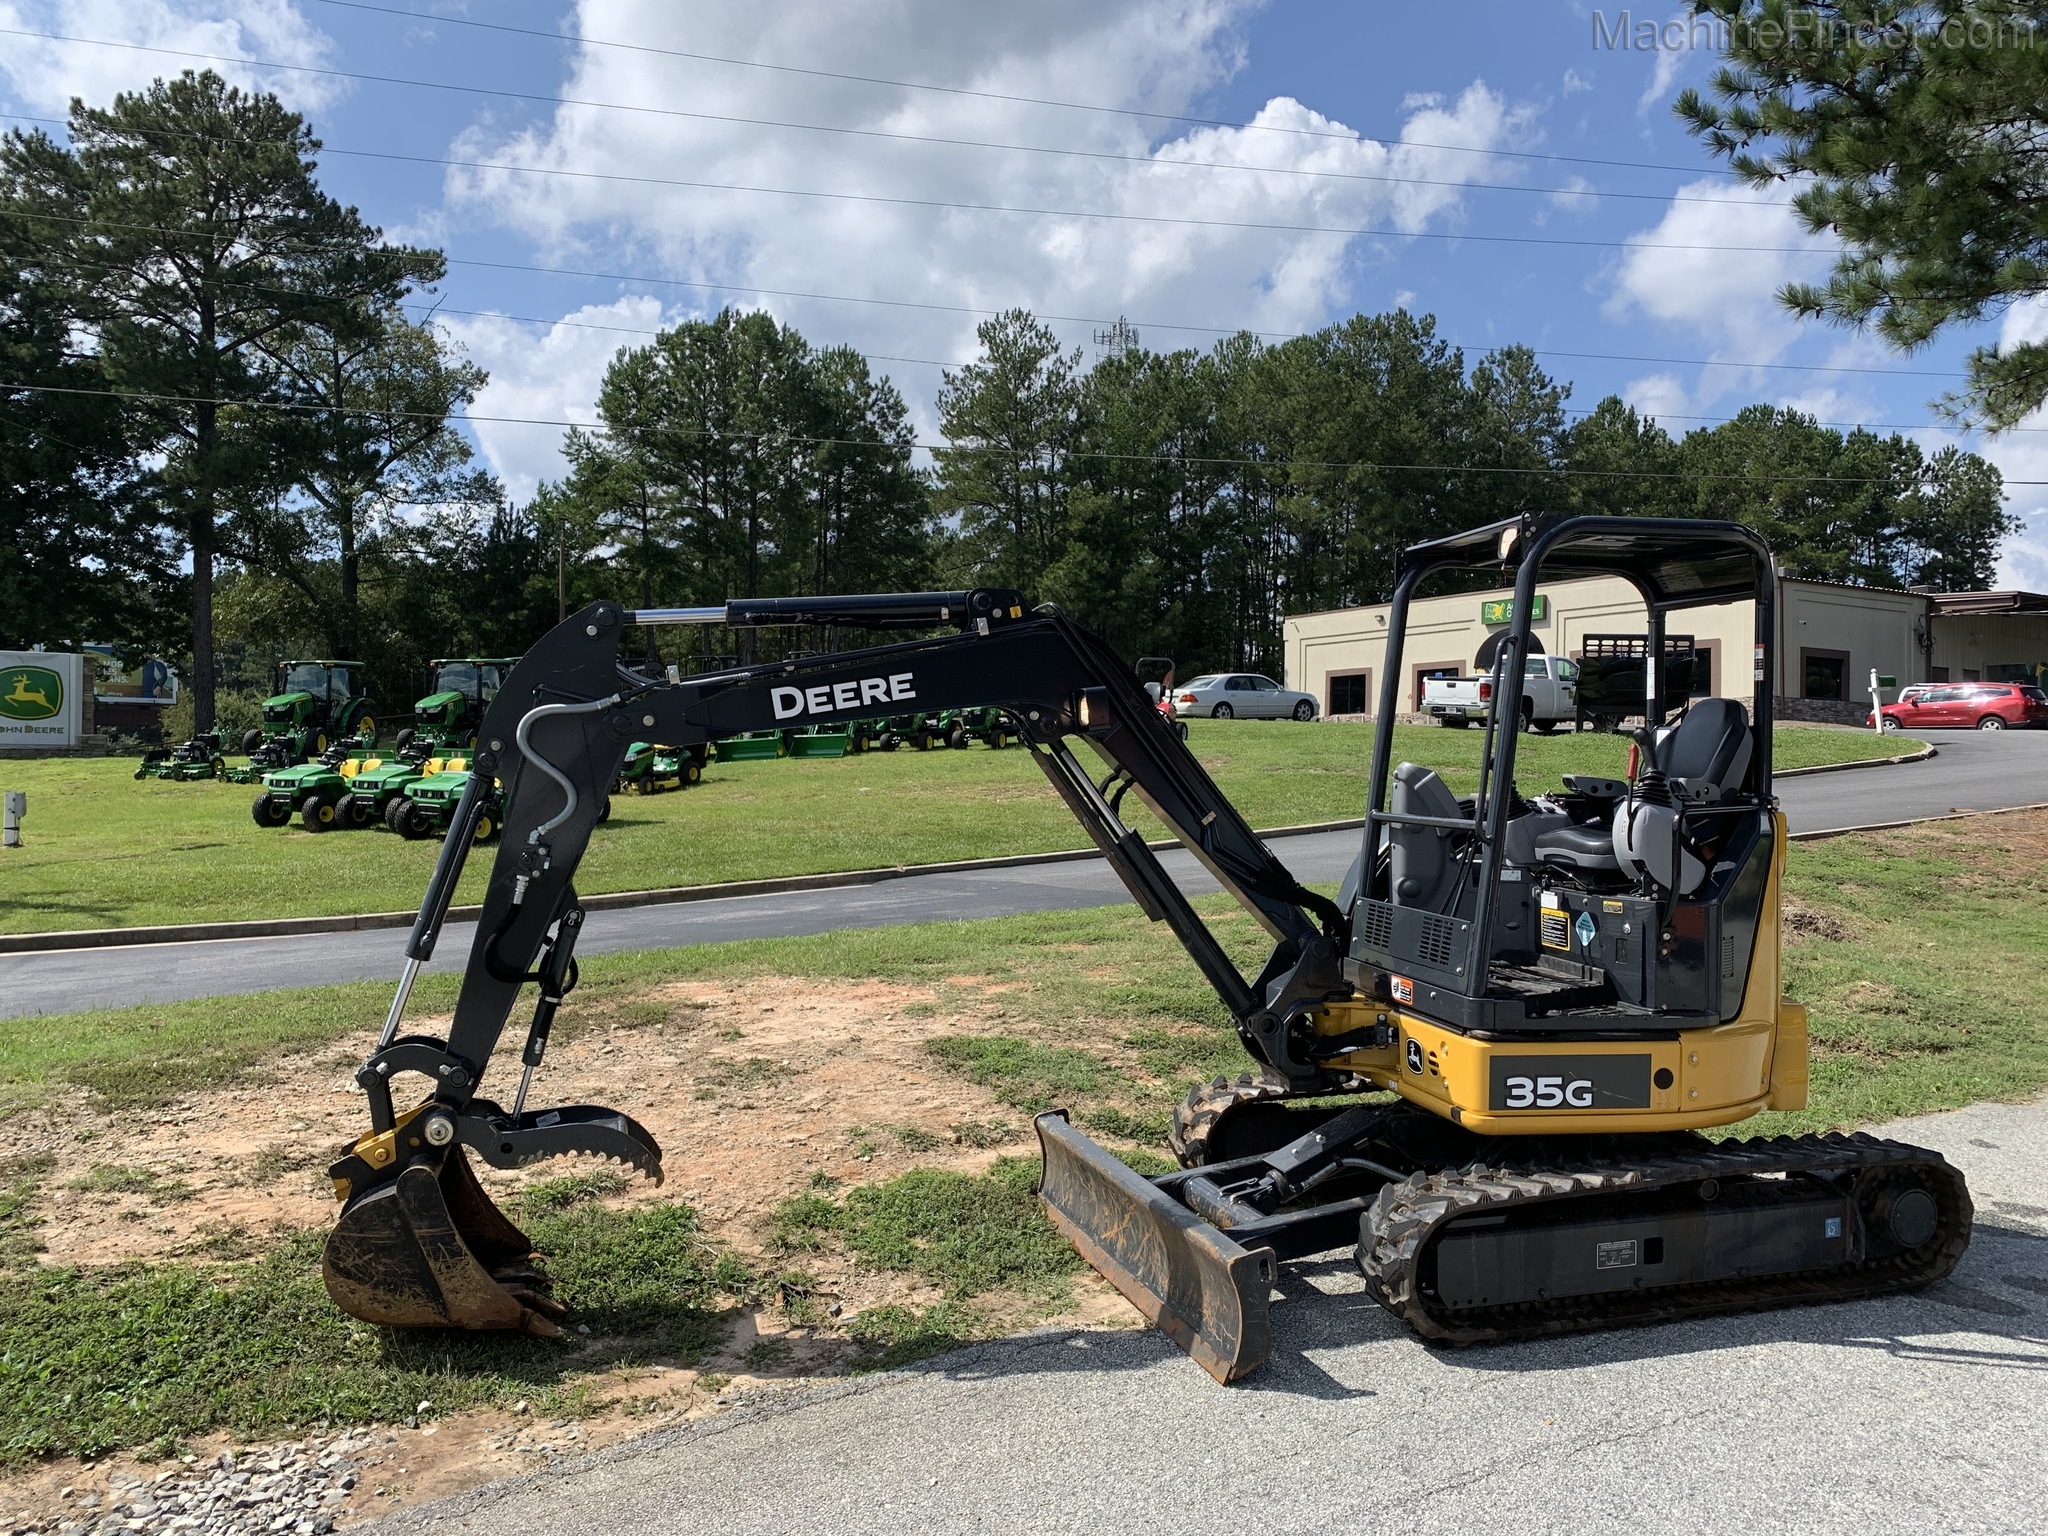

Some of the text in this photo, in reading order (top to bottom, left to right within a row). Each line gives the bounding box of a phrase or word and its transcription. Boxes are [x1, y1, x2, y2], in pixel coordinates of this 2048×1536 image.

[770, 672, 916, 720] DEERE
[24, 725, 65, 734] DEERE
[1506, 1076, 1593, 1108] 35G
